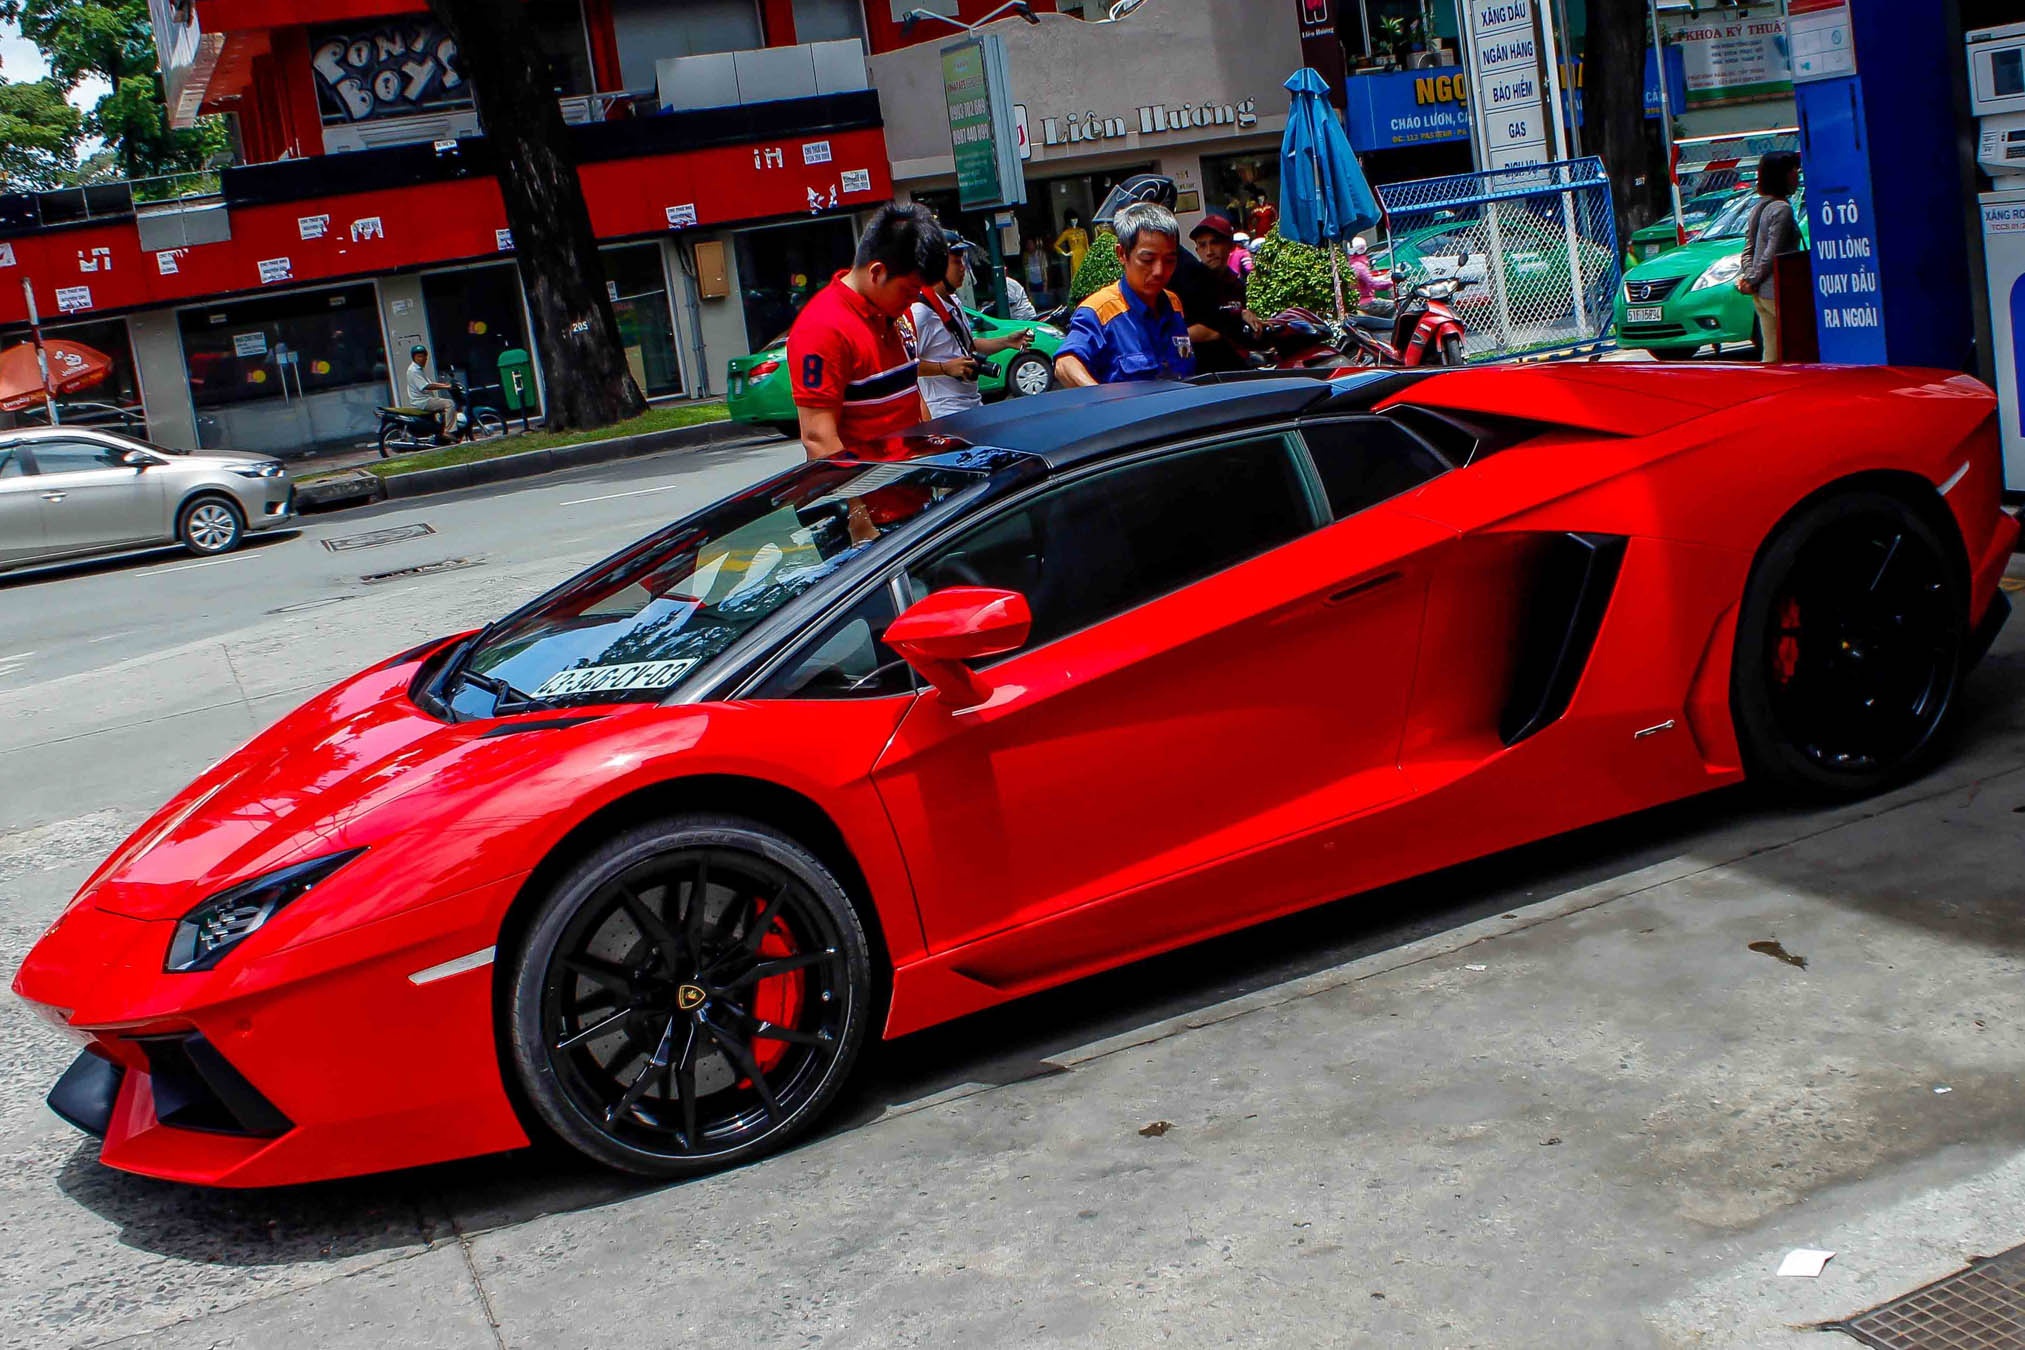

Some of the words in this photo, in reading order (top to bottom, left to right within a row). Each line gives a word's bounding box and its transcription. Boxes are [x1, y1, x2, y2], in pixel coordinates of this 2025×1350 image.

[1687, 28, 1722, 41] KHOA
[1483, 43, 1508, 65] NGÂN
[1510, 39, 1533, 58] HÀNG
[1493, 81, 1511, 101] BẢO
[1513, 74, 1533, 97] HIỂM
[1040, 110, 1127, 145] Liên
[1391, 113, 1421, 130] CHÁO
[1509, 121, 1526, 138] GAS
[1822, 201, 1833, 225] Ô
[1837, 199, 1858, 225] TÔ
[1817, 240, 1836, 260] VUI
[1839, 234, 1870, 259] LÒNG
[1819, 274, 1848, 297] QUAY
[1852, 264, 1876, 293] ĐẦU
[1824, 309, 1840, 328] RA
[1842, 302, 1878, 327] NGOÀI
[803, 354, 823, 388] 8
